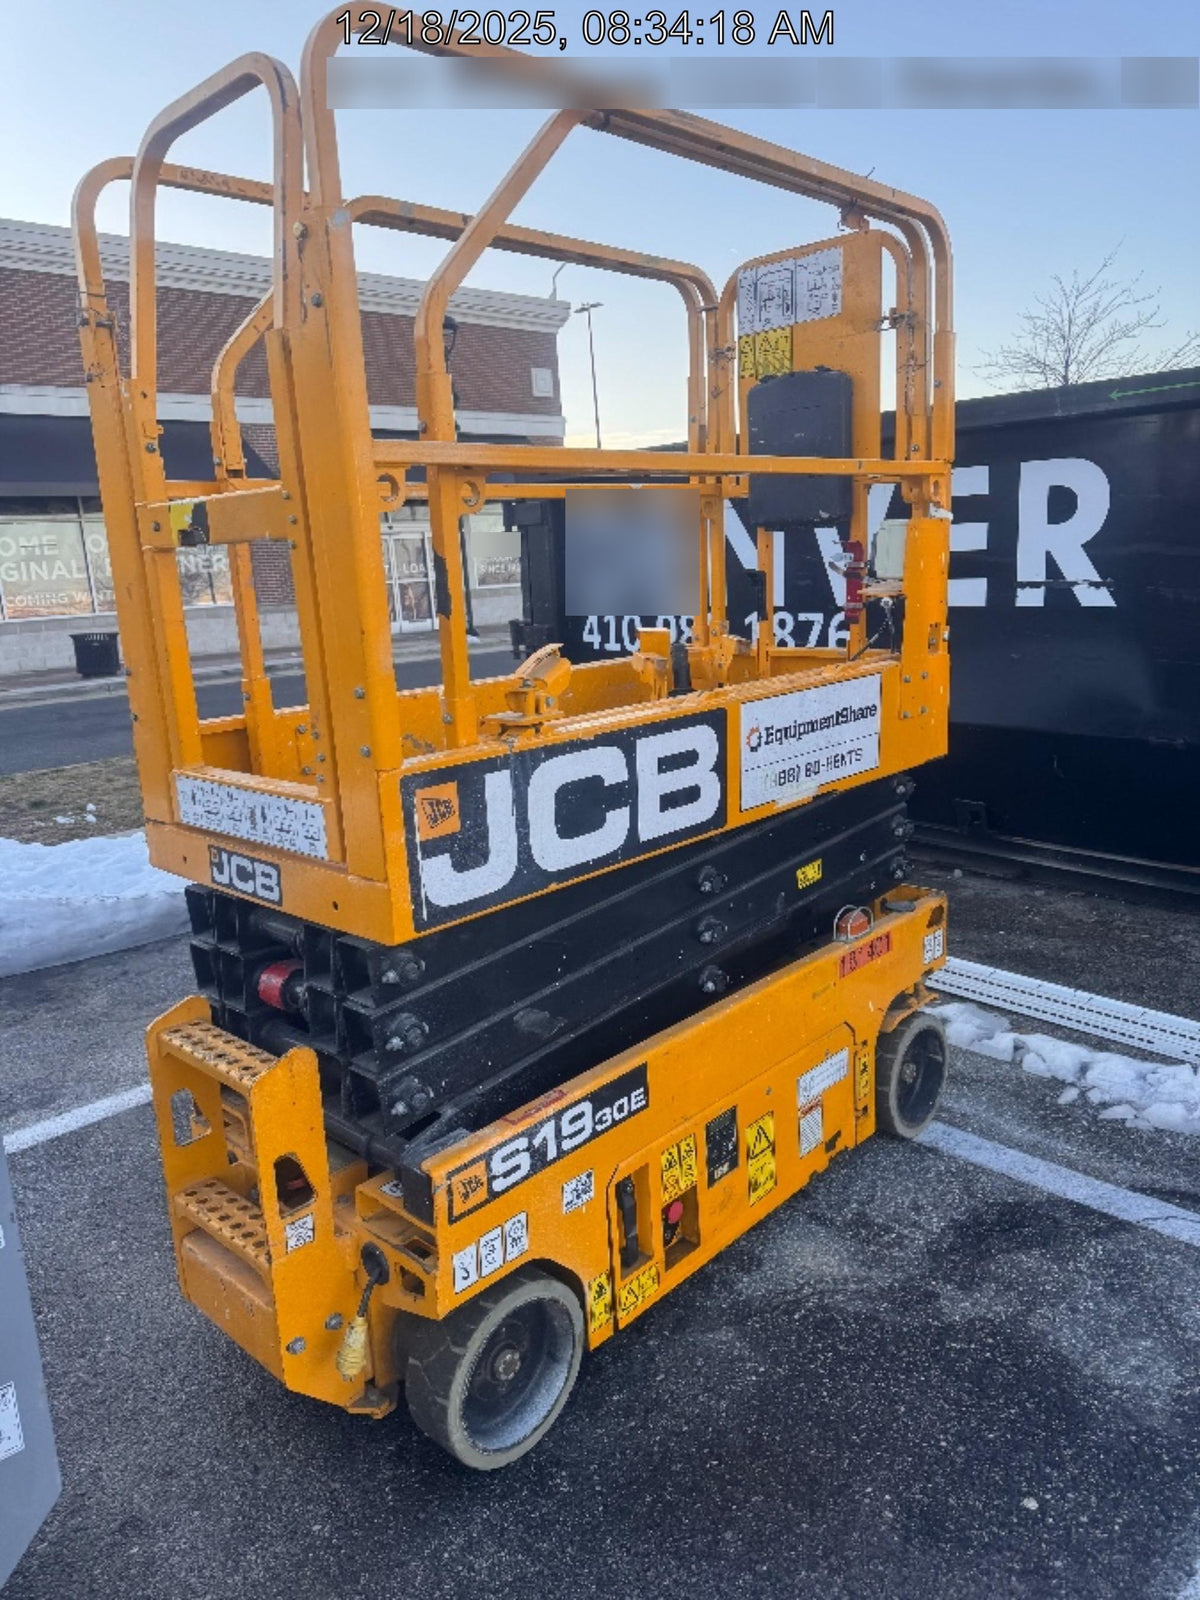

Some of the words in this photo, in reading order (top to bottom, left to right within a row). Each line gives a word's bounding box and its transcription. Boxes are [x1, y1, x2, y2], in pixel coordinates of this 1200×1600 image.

[582, 615, 640, 651] 410
[744, 611, 850, 648] 1876
[764, 703, 877, 746] EquipmentShare
[421, 724, 721, 907] JCB
[212, 851, 280, 902] JCB
